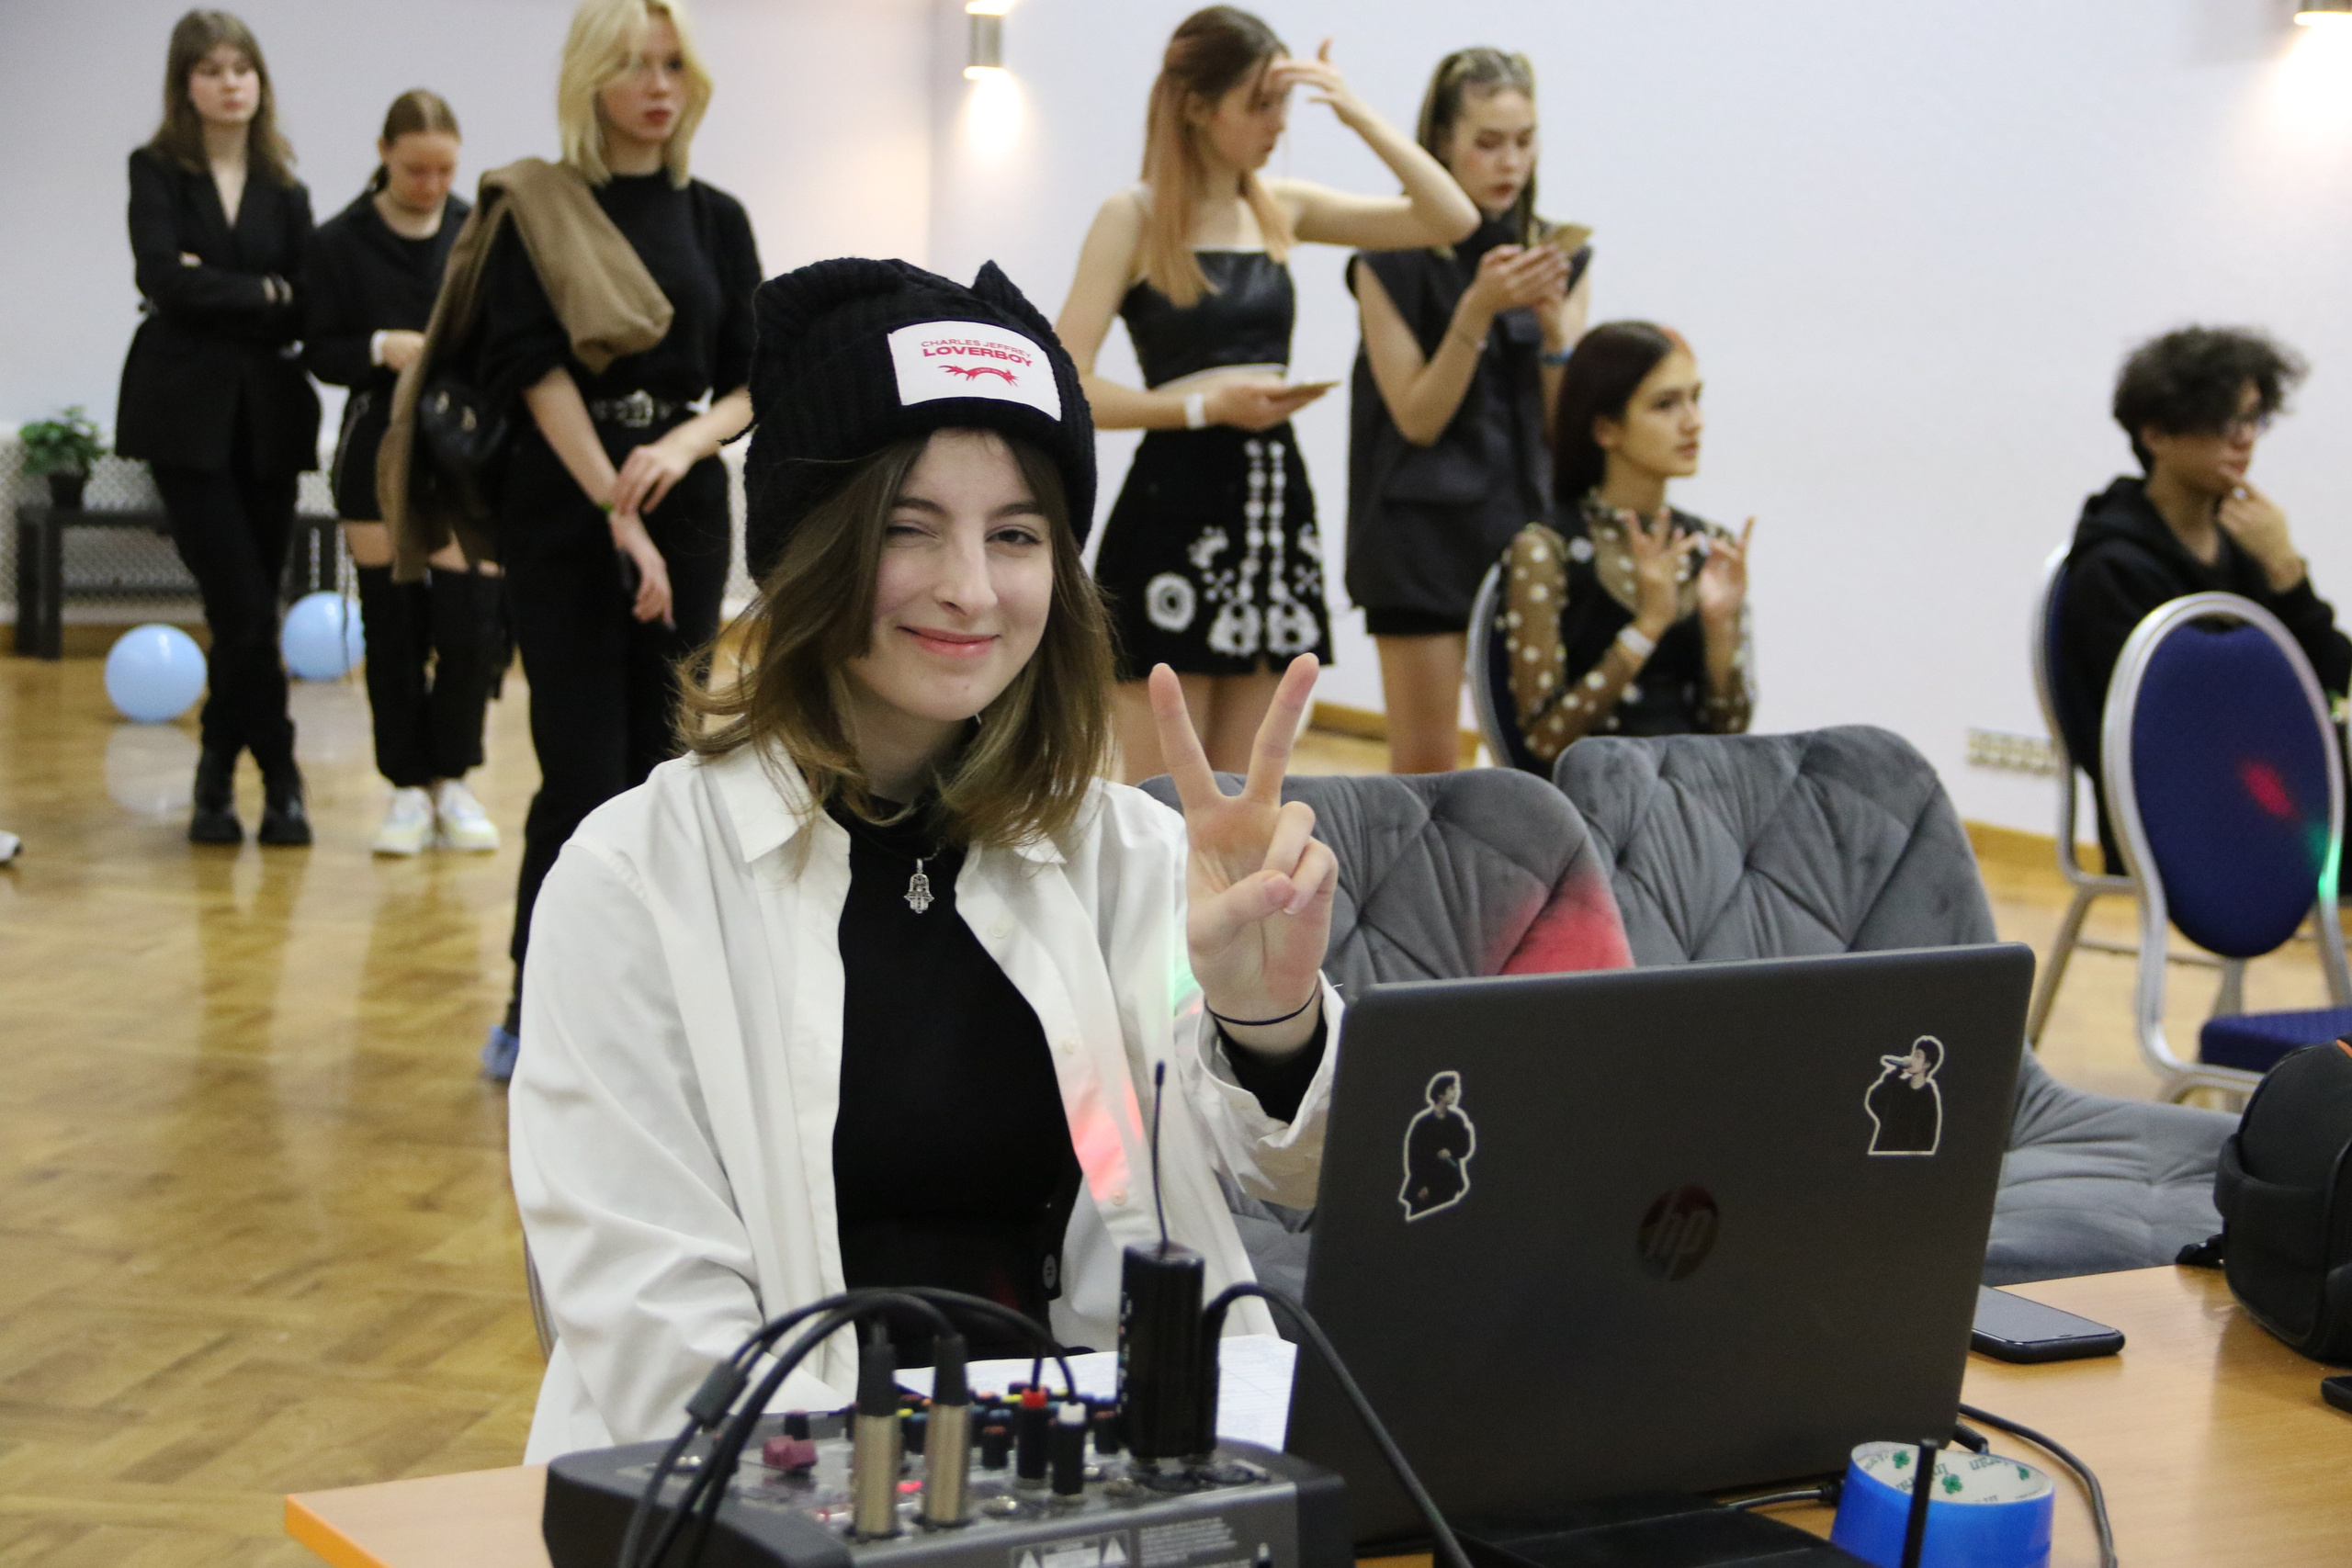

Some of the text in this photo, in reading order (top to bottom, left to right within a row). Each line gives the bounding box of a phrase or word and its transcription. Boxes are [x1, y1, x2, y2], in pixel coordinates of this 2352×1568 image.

[922, 339, 1031, 357] CHARLES JEFFREY
[923, 346, 1032, 367] LOVERBOY
[1643, 1190, 1713, 1282] hp
